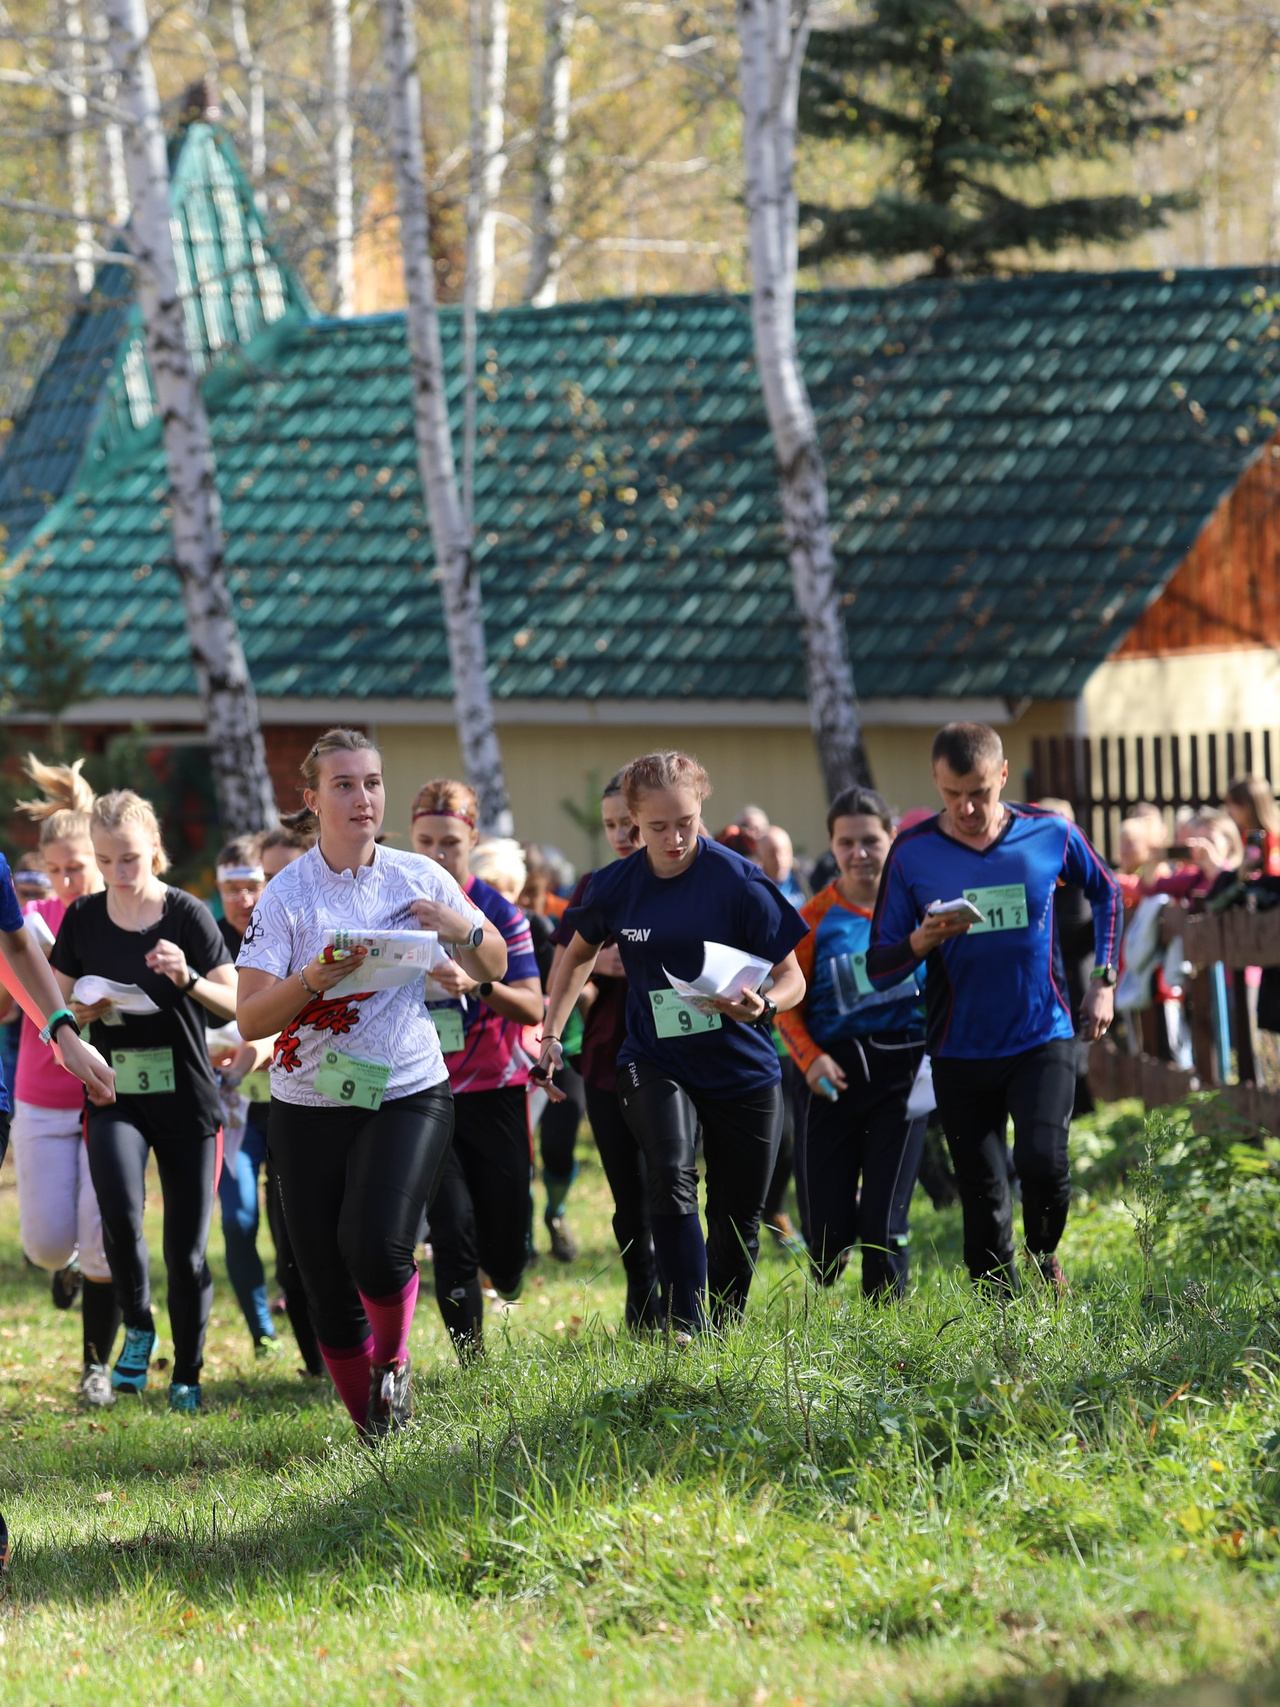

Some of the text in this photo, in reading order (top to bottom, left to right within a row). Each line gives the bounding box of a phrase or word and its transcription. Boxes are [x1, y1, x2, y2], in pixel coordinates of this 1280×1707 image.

[987, 908, 1004, 928] 11
[1015, 911, 1022, 925] 2
[678, 1010, 692, 1032] 9
[706, 1014, 715, 1028] 2
[138, 1071, 150, 1091] 3
[165, 1075, 170, 1087] 1
[340, 1080, 355, 1100] 9
[370, 1092, 377, 1107] 1
